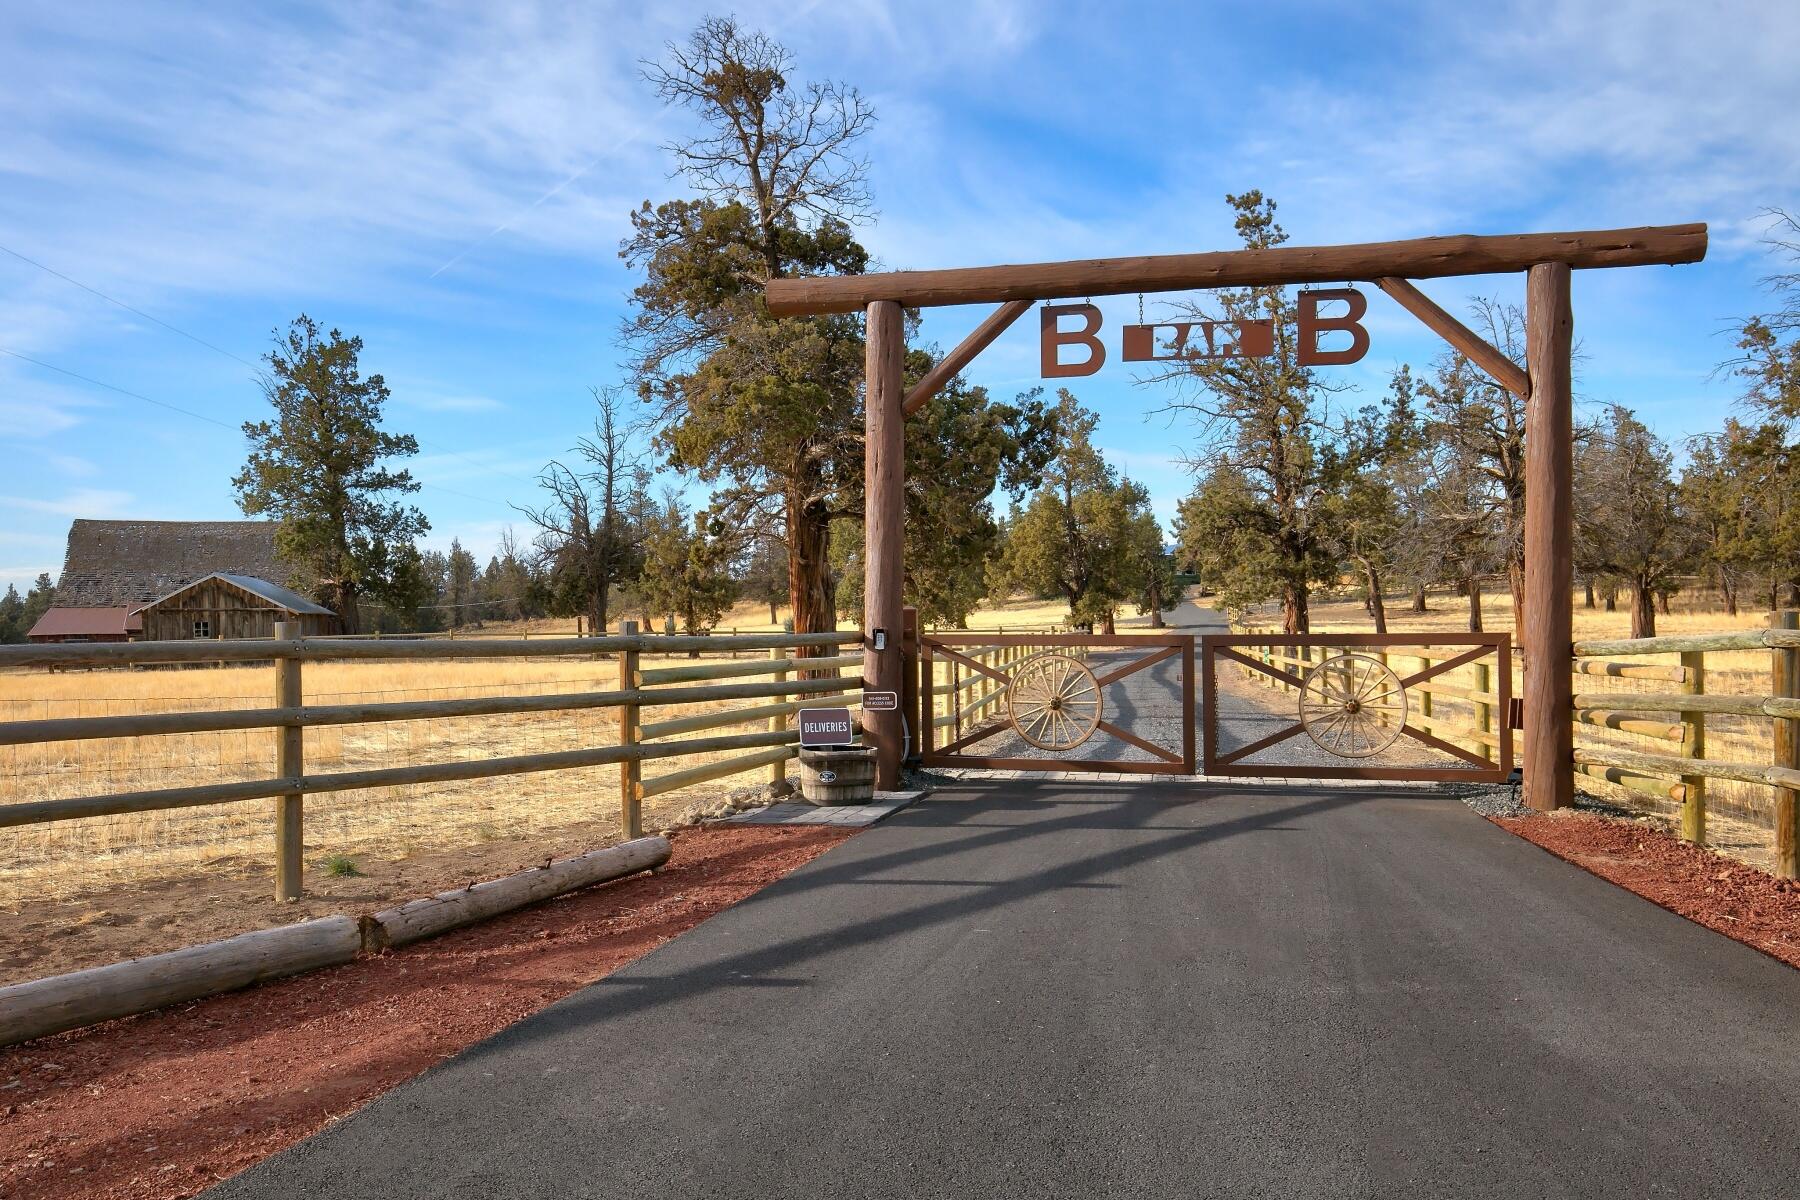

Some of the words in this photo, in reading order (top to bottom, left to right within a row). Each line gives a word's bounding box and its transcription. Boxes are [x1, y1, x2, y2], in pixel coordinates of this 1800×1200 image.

[1041, 304, 1106, 379] B
[1152, 322, 1242, 358] BAR
[1297, 288, 1371, 367] B
[804, 721, 848, 733] DELIVERIES
